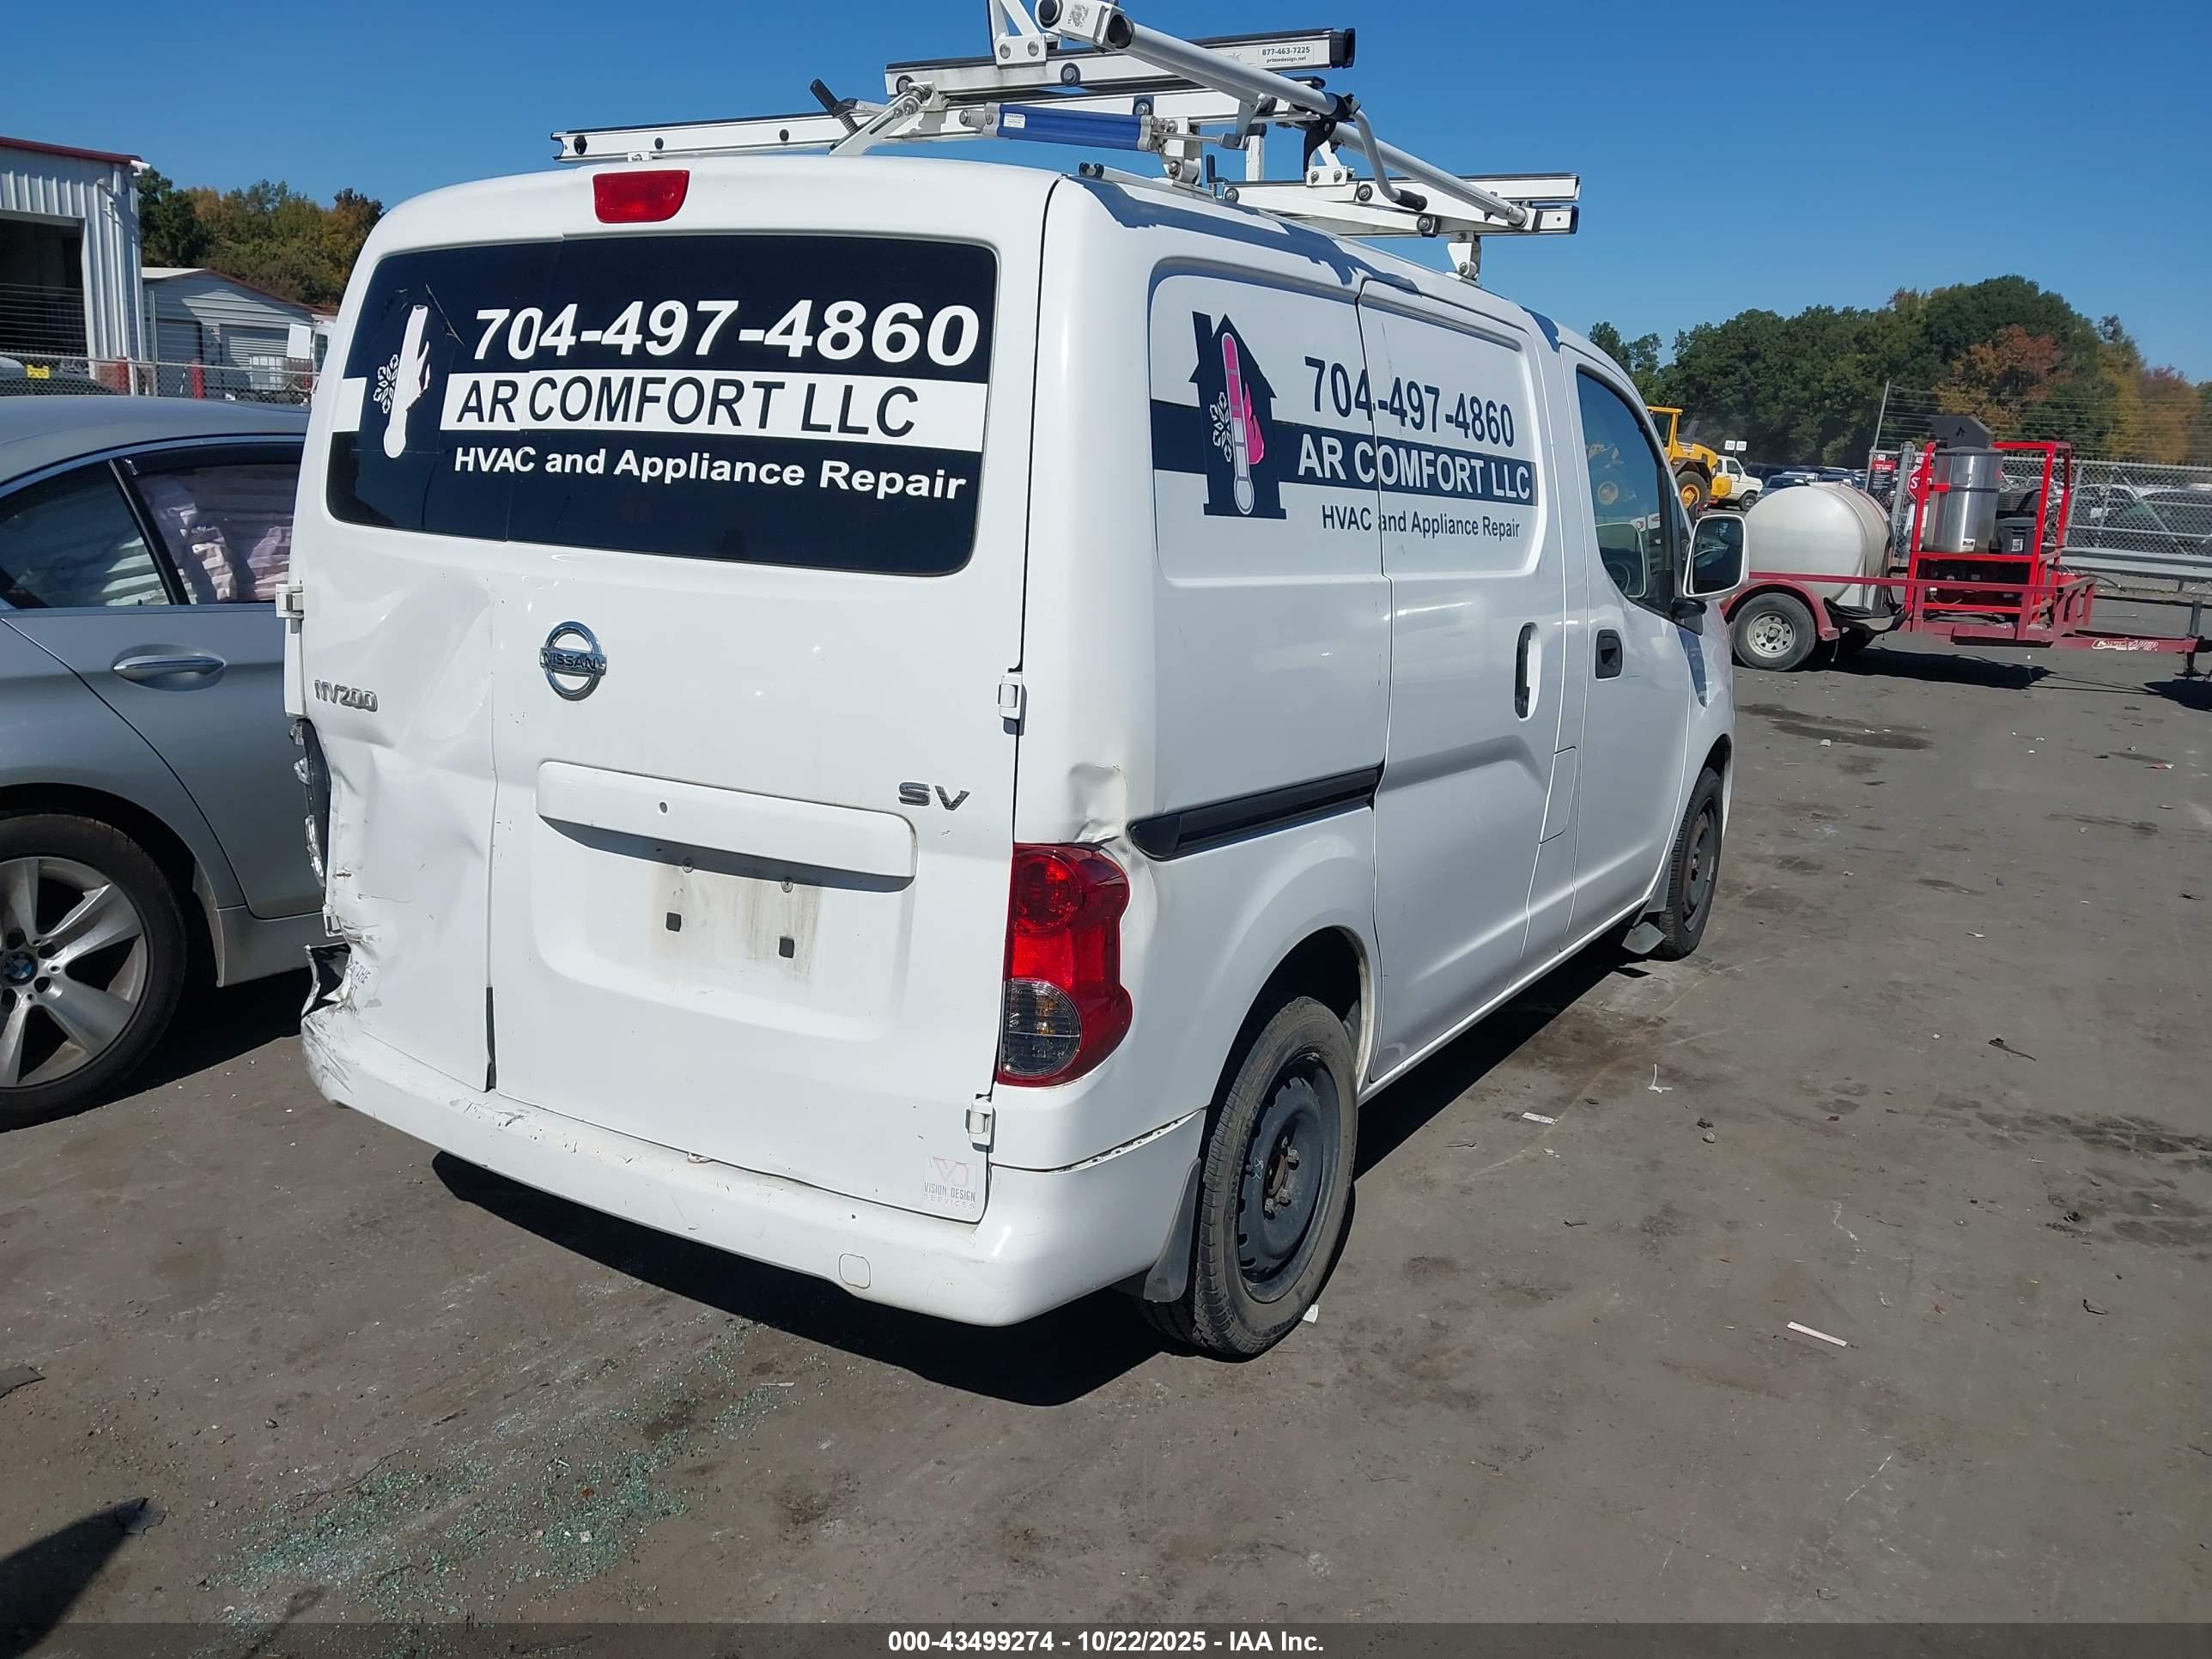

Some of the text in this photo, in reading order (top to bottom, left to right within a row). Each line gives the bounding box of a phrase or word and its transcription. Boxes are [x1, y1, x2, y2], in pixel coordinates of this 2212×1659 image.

[1261, 46, 1311, 56] 877-463-7225
[474, 301, 980, 367] 704-497-4860
[456, 375, 919, 438] AR COMFORT LLC
[1304, 356, 1515, 448] 704-497-4860
[454, 447, 967, 500] HVAC and Appliance Repair
[1297, 433, 1530, 500] AR COMFORT LLC
[1322, 504, 1520, 542] HVAC and Appliance Repair
[543, 652, 597, 670] NISSAN
[314, 679, 378, 713] NV200
[898, 781, 970, 811] SV
[922, 1193, 976, 1210] SERVICES
[924, 1181, 975, 1203] VISION DESIGN
